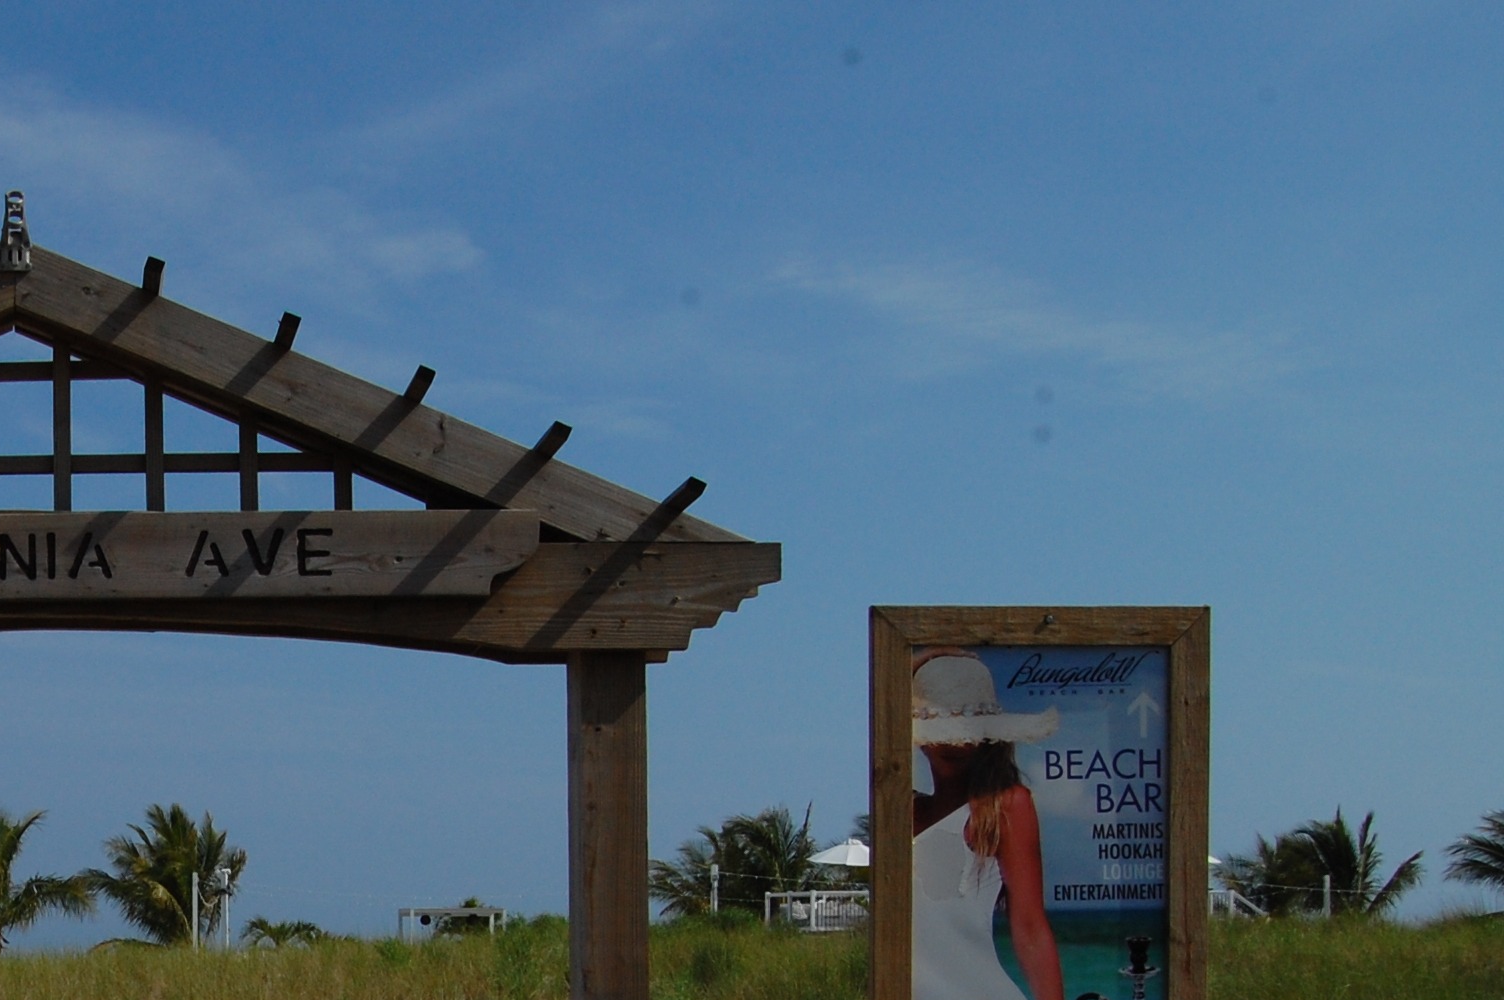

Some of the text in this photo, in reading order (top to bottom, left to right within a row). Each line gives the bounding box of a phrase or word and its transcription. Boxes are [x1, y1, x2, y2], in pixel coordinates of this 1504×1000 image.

[185, 527, 333, 577] AVE
[1046, 749, 1161, 780] BEACH
[1096, 783, 1163, 813] BAR
[1092, 823, 1163, 839] MARTINIS
[1098, 843, 1163, 859] HOOKAH
[1103, 863, 1163, 880] LOUNGE
[1054, 884, 1164, 901] ENTERTAINMENT
